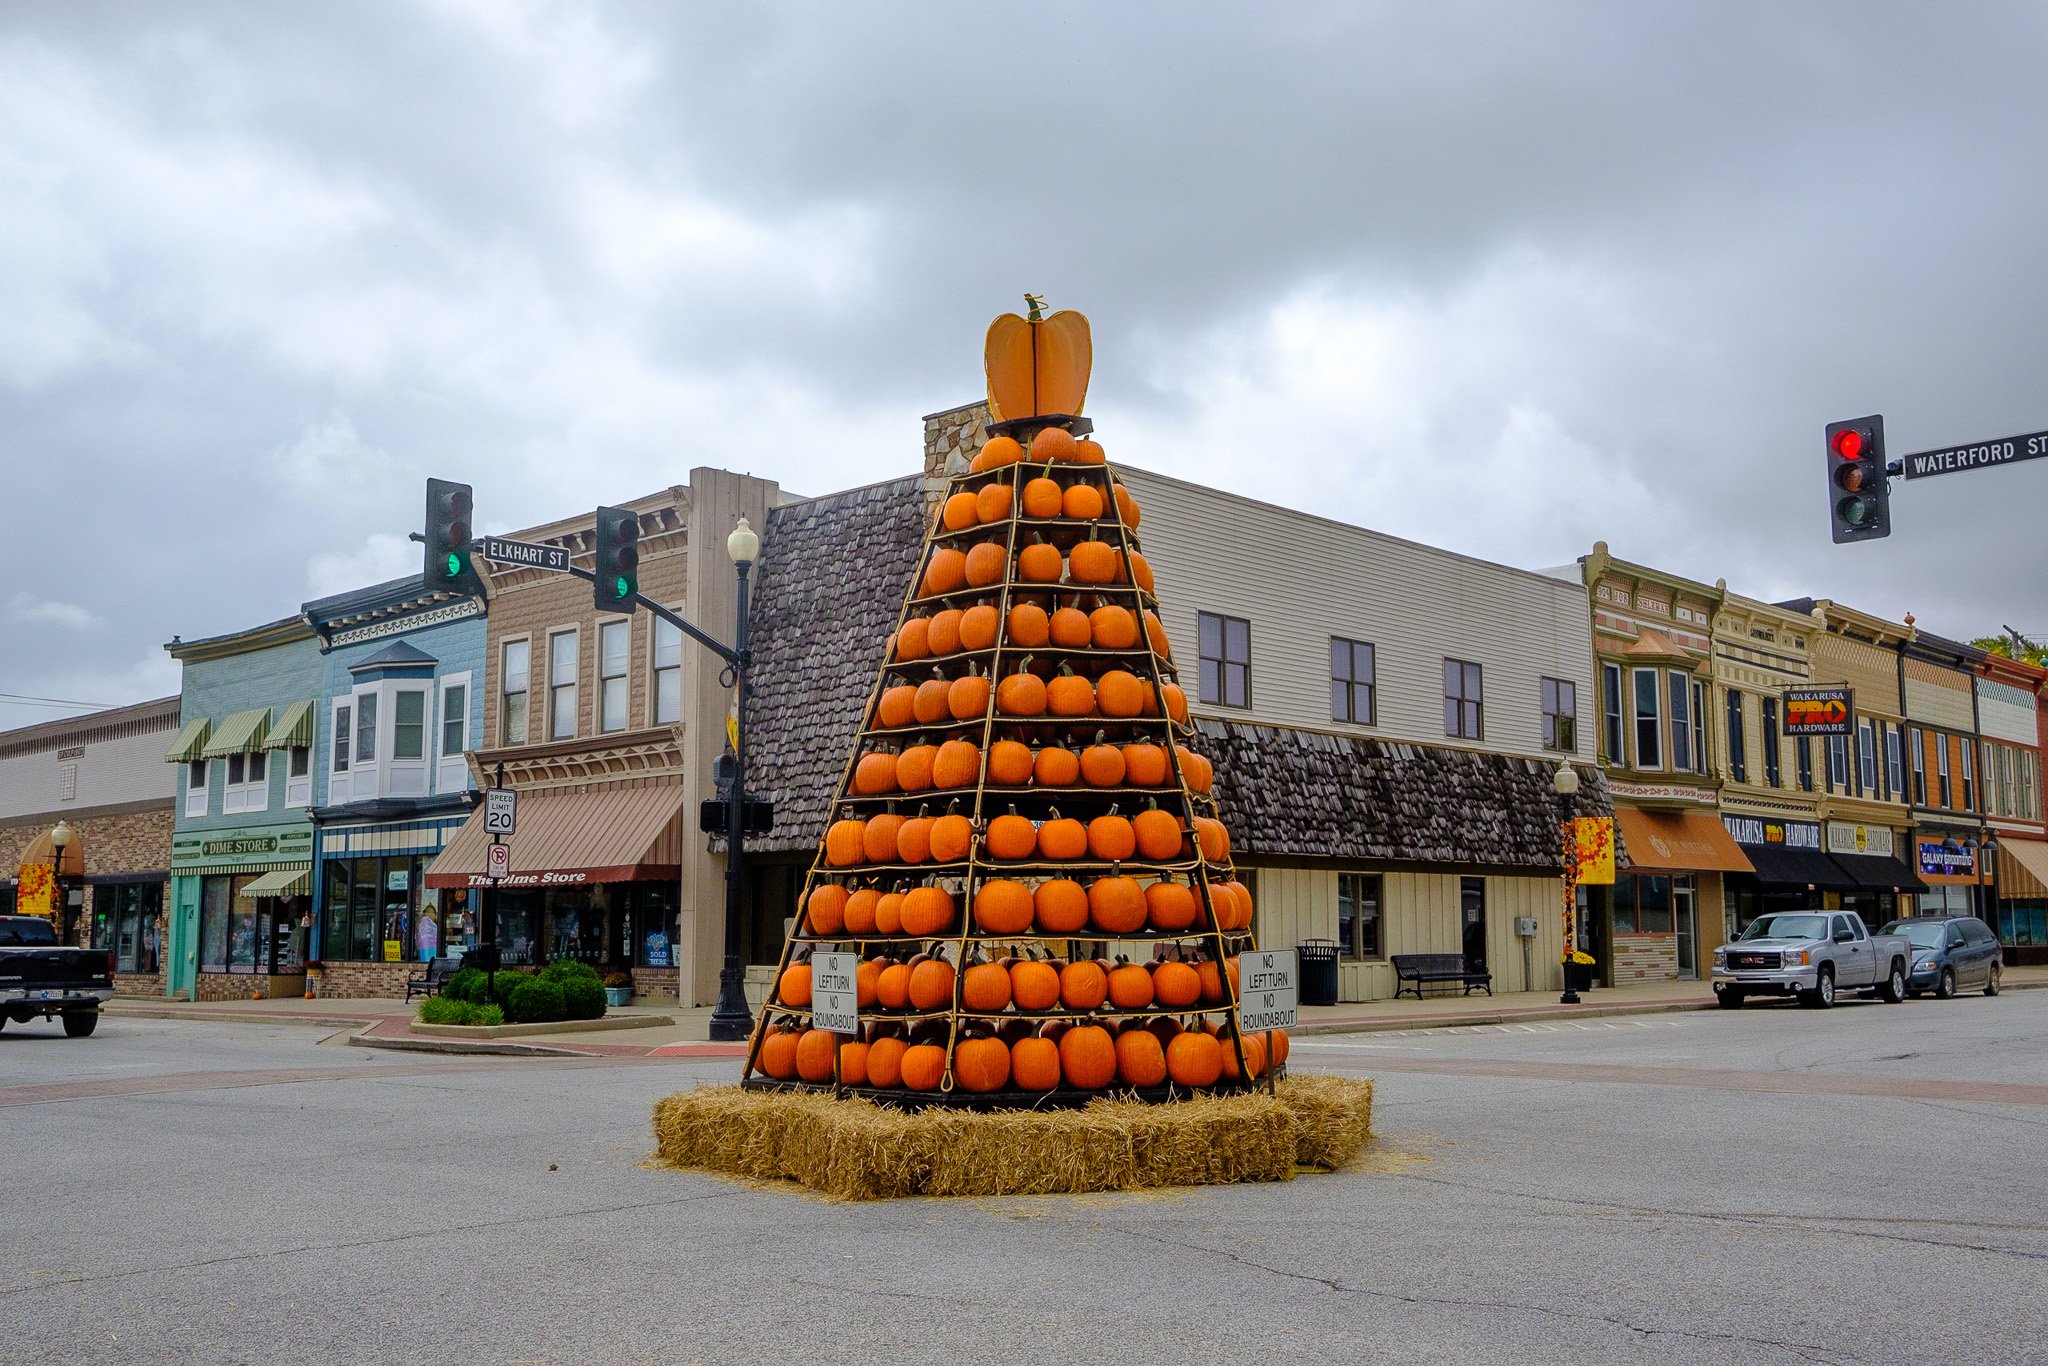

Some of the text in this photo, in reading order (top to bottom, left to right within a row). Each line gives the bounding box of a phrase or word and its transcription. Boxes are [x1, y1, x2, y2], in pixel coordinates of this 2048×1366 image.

[1914, 435, 2048, 474] WATERFORD ST
[490, 542, 563, 566] ELKHART ST
[1790, 692, 1844, 701] WAKARUSA
[1787, 700, 1847, 725] PRO
[1789, 723, 1845, 732] HARDWARE
[489, 794, 513, 803] SPEED
[488, 812, 512, 828] 20
[1724, 817, 1820, 848] WAKARUSA PRO HARDWARE
[209, 842, 232, 854] DIME
[235, 839, 269, 853] STORE
[1922, 852, 1972, 866] GALAXY GROOMING
[468, 874, 494, 885] The
[541, 872, 587, 883] Store
[829, 957, 838, 971] NO
[1262, 954, 1274, 969] NO
[818, 974, 850, 990] LEFT TURN
[1249, 971, 1288, 989] LEFT TURN
[829, 995, 839, 1010] NO
[1263, 993, 1275, 1008] NO
[815, 1012, 855, 1030] ROUNDABOUT
[1243, 1010, 1295, 1030] ROUNDABOUT
